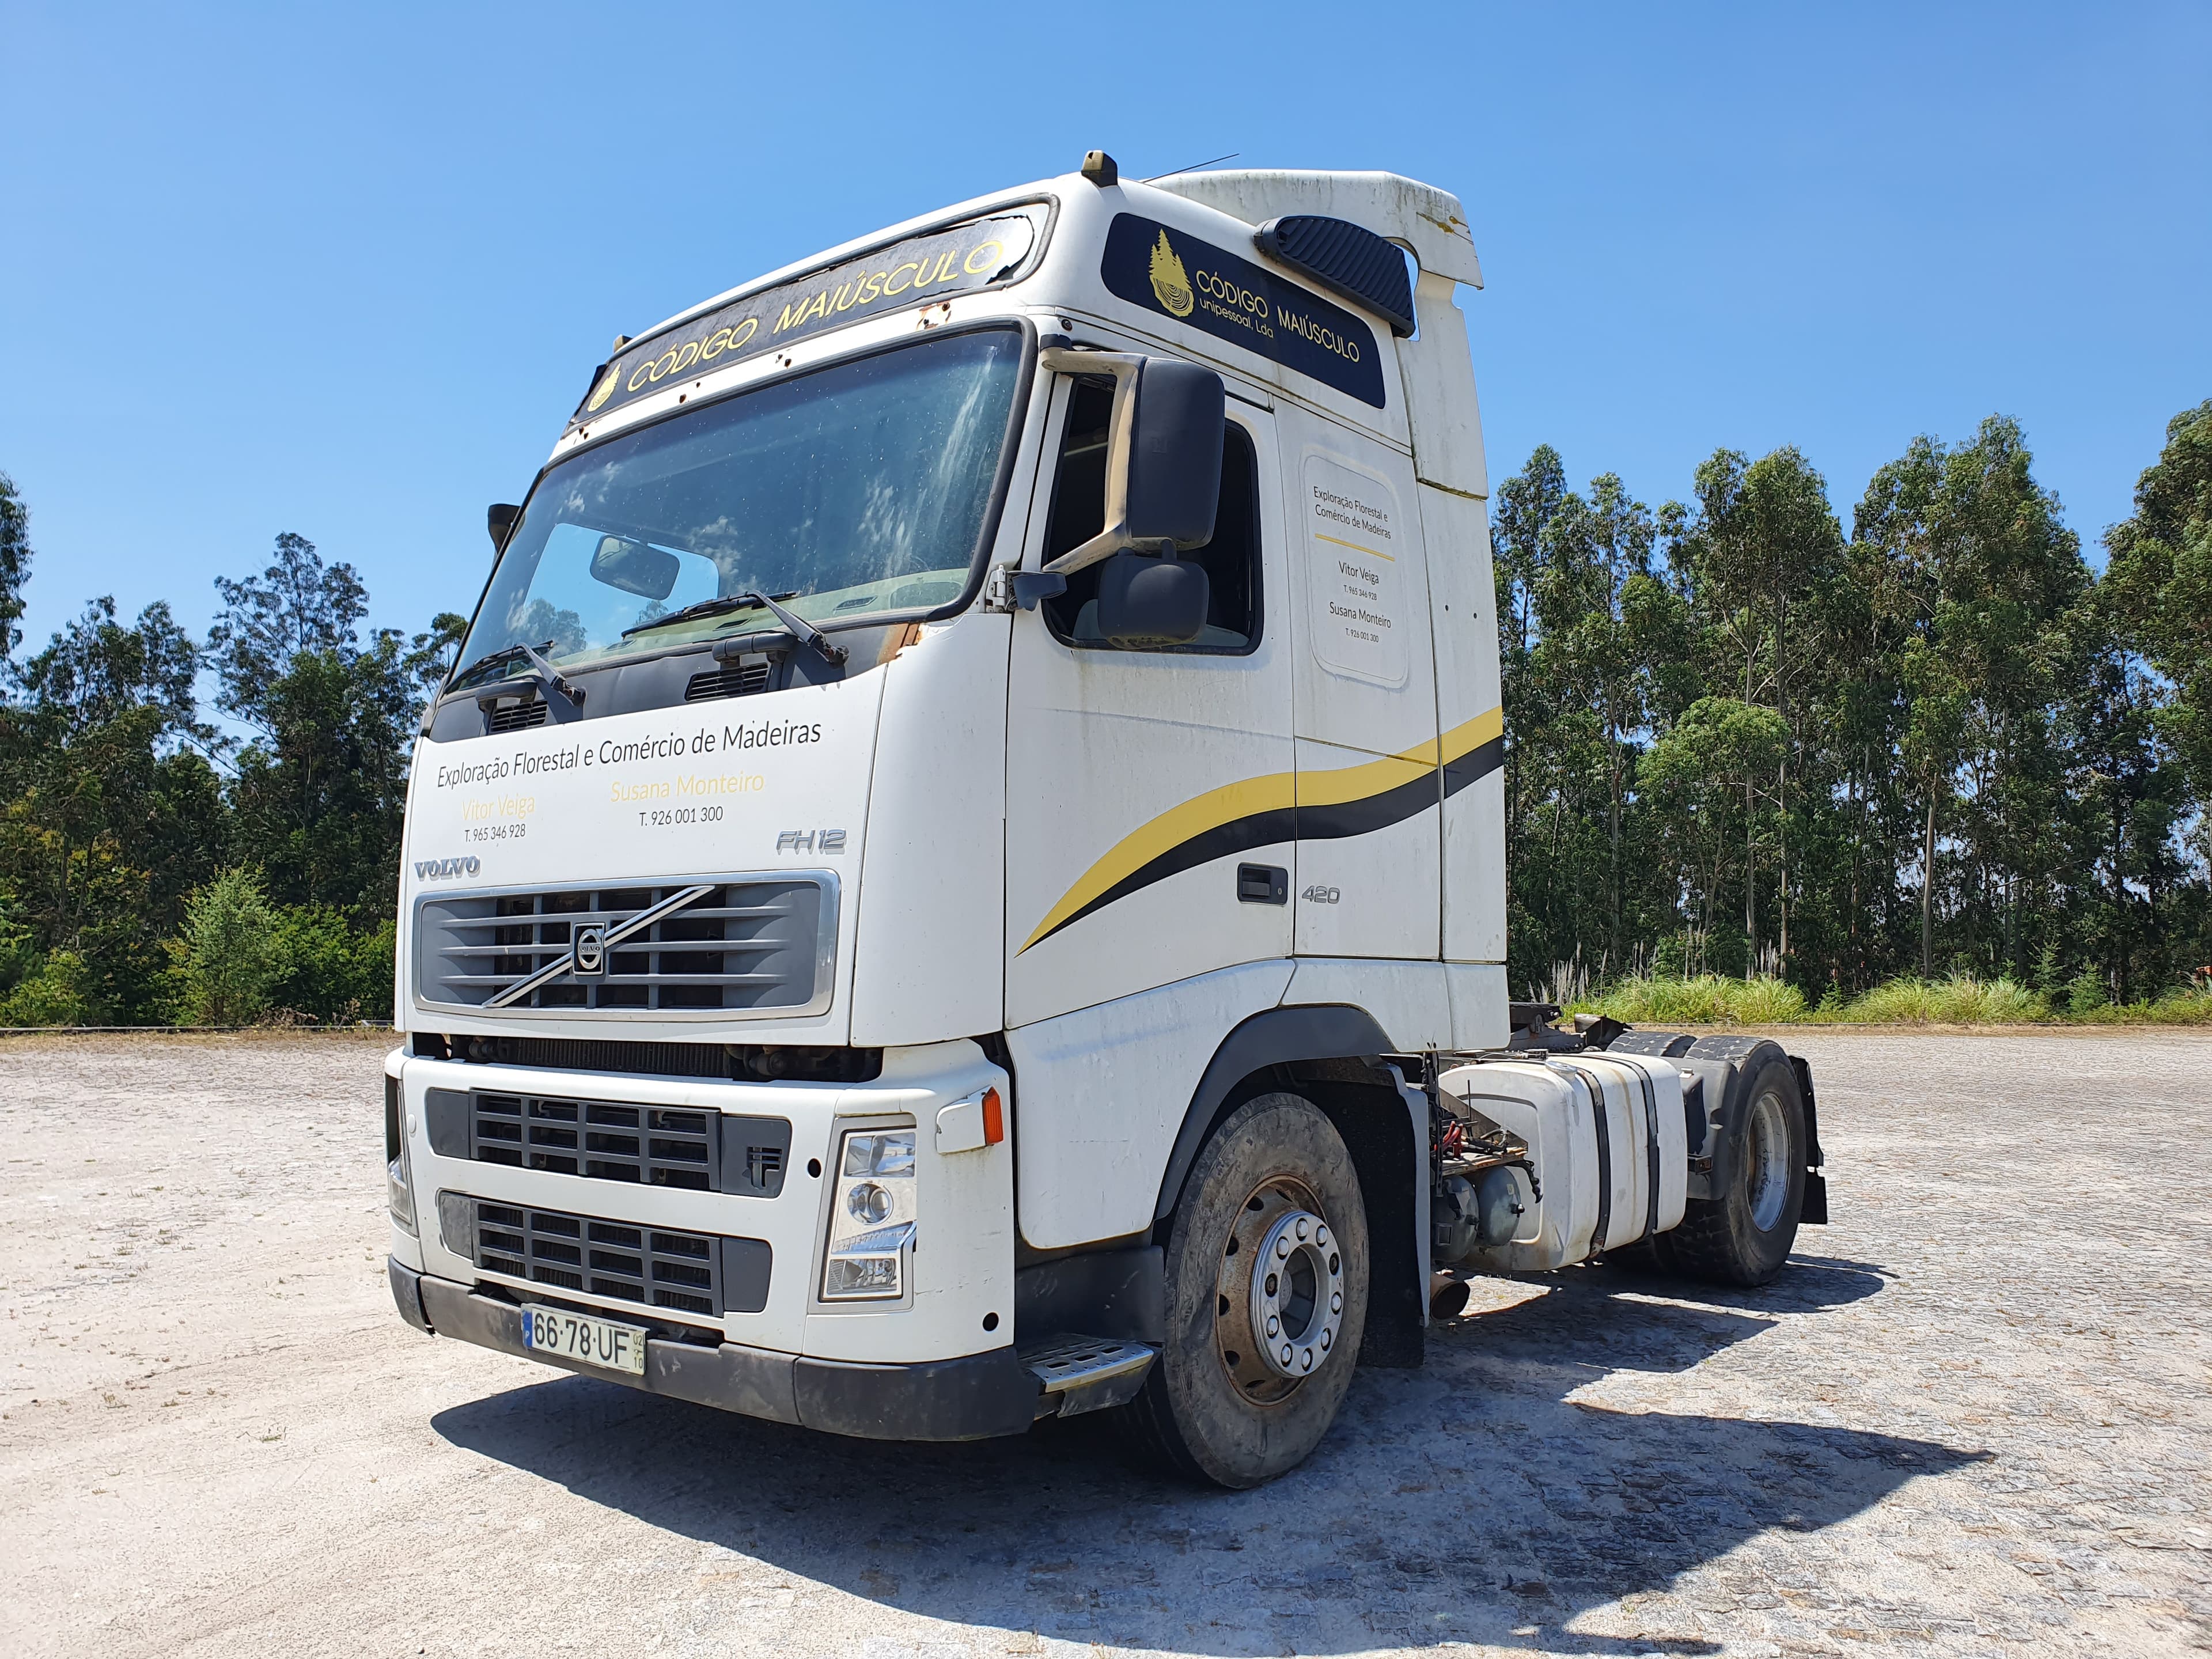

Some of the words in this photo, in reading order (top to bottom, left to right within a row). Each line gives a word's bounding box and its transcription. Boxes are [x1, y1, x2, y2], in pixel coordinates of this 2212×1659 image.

[627, 318, 758, 392] CÓDIGO
[772, 240, 1003, 334] MAIÚSCULO
[1196, 270, 1268, 318] CÓDIGO
[1277, 305, 1359, 362] MAIÚSCULO
[1199, 297, 1253, 330] unipessoal,
[1255, 320, 1274, 339] Lda
[1313, 486, 1353, 509] Exploração
[1354, 500, 1382, 520] Florestal
[1384, 514, 1388, 522] e
[1315, 504, 1350, 525] Comércio
[1352, 516, 1360, 528] de
[1362, 519, 1391, 539] Madeiras
[1339, 560, 1358, 578] Vitor
[1359, 567, 1379, 585] Veiga
[1343, 585, 1349, 593] T.
[1349, 586, 1358, 596] 965
[1359, 589, 1368, 598] 346
[1369, 592, 1377, 600] 928
[1330, 601, 1357, 619] Susana
[1359, 608, 1391, 628] Monteiro
[1346, 628, 1350, 636] T.
[1350, 629, 1359, 638] 926
[1360, 631, 1369, 641] 001
[1370, 634, 1378, 643] 300
[438, 757, 509, 790] Exploração
[513, 744, 579, 776] Florestal
[584, 749, 593, 766] e
[599, 732, 684, 764] Comércio
[692, 728, 715, 753] de
[723, 719, 821, 751] Madeiras
[610, 781, 670, 802] Susana
[676, 770, 764, 797] Monteiro
[461, 798, 494, 820] Vitor
[498, 793, 535, 819] Veiga
[639, 812, 647, 826] T.
[651, 810, 672, 825] 926
[675, 808, 696, 823] 001
[700, 806, 724, 821] 300
[465, 830, 471, 842] T.
[473, 828, 488, 841] 965
[491, 825, 506, 839] 346
[509, 823, 525, 838] 928
[414, 855, 480, 879] VOLVO
[1301, 885, 1340, 904] 420
